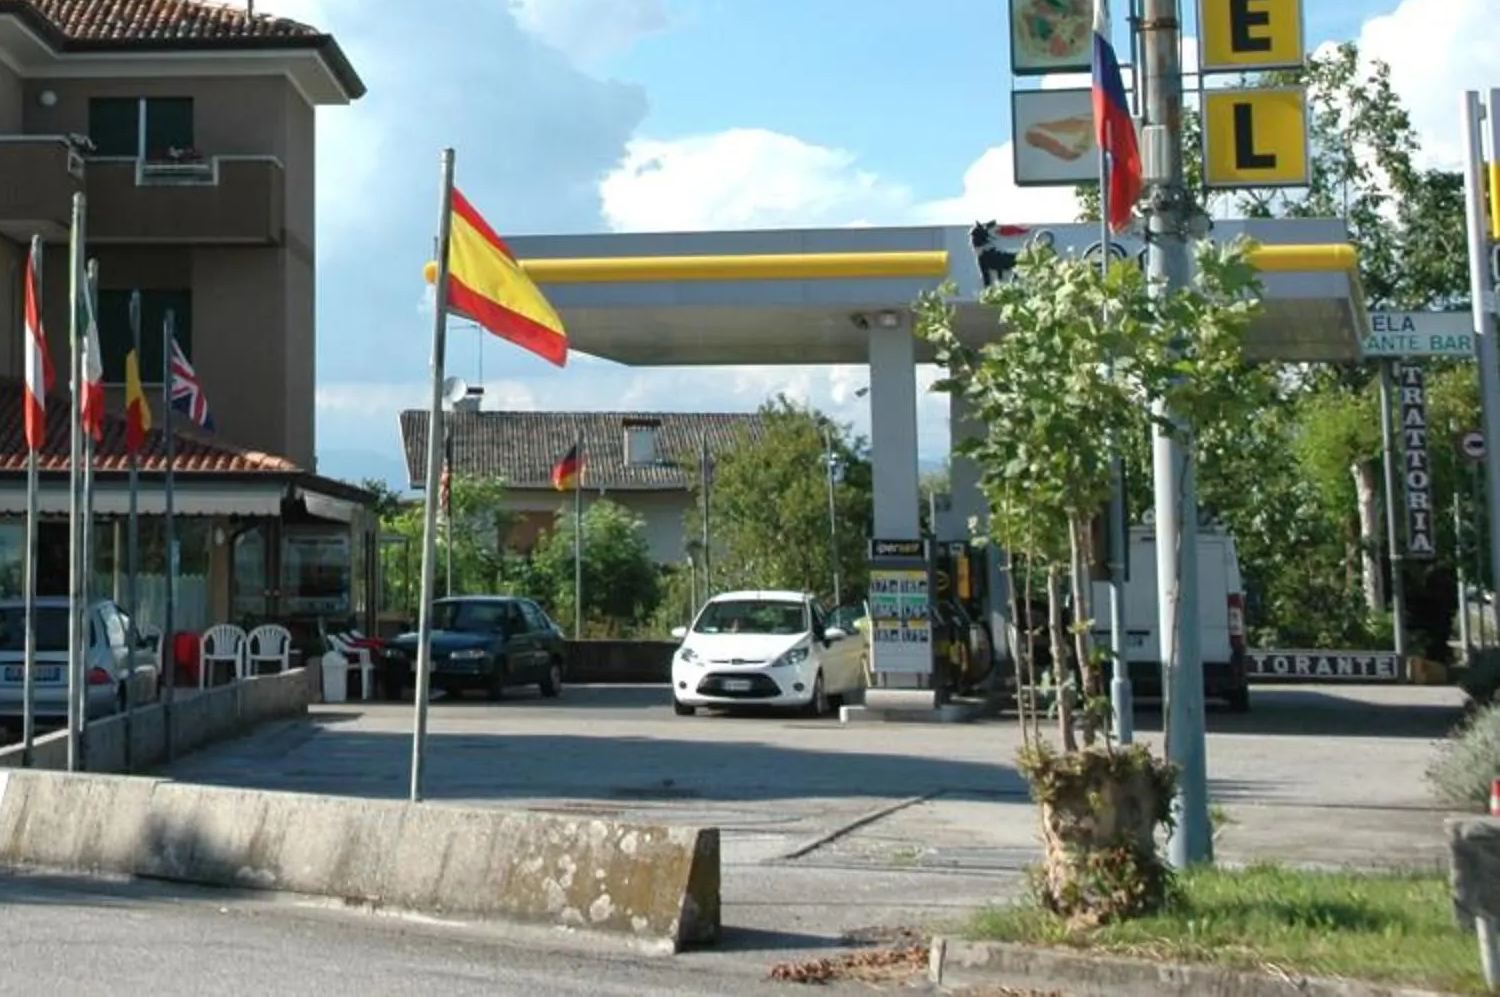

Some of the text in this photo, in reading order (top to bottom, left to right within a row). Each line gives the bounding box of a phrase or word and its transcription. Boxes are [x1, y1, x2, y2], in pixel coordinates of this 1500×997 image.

[1373, 315, 1416, 332] ELA
[1430, 334, 1471, 350] BAR
[1402, 366, 1432, 551] TRATTORIA
[1253, 654, 1392, 677] TORANTE
